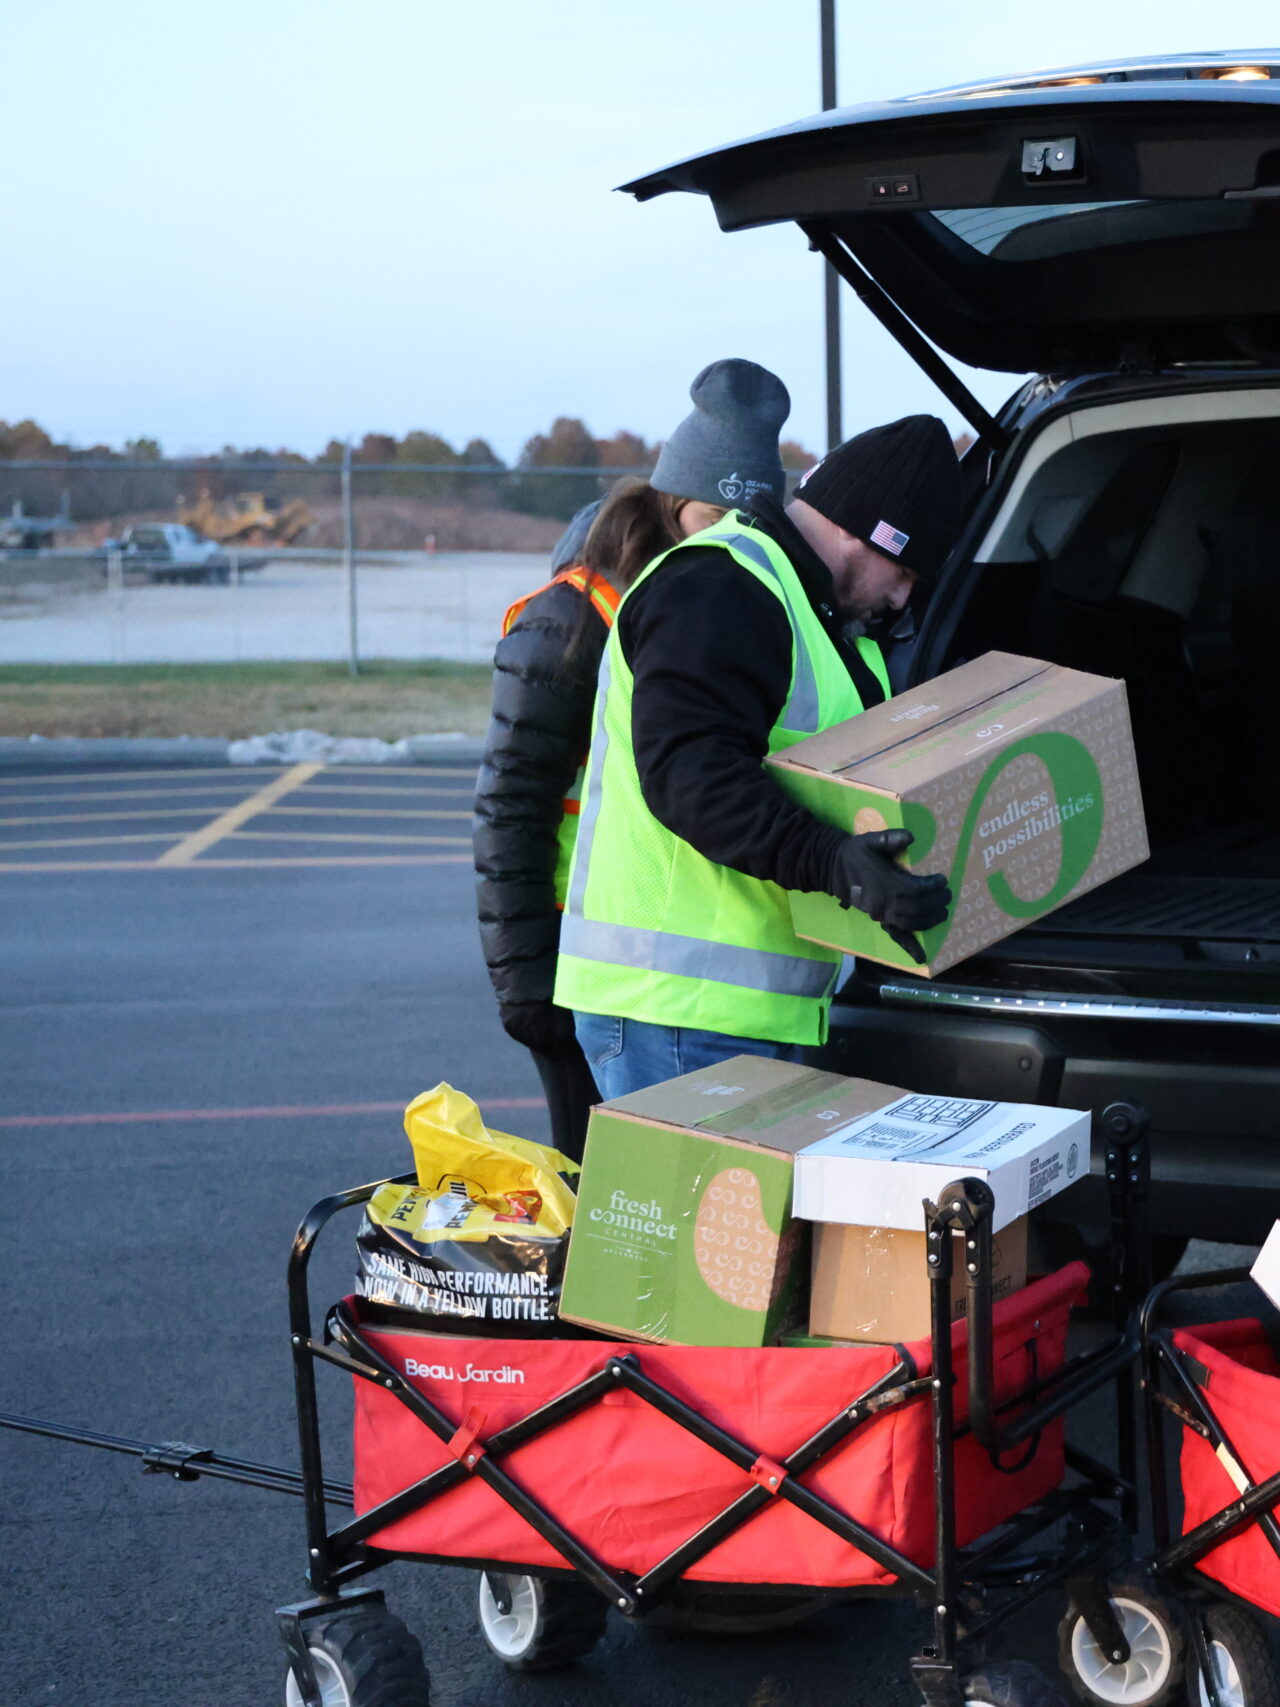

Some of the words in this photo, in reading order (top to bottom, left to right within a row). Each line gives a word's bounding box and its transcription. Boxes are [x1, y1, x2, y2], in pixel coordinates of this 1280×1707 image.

[979, 791, 1049, 838] endless
[982, 793, 1094, 870] possibilities
[589, 1207, 678, 1241] connect
[609, 1189, 662, 1221] fresh
[367, 1251, 407, 1279] SAME
[408, 1261, 440, 1287] HIGH
[437, 1270, 554, 1296] PERFORMANCE.
[363, 1275, 400, 1303] NOW
[400, 1282, 417, 1306] IN
[418, 1286, 429, 1309] A
[432, 1287, 487, 1318] YELLOW
[492, 1297, 555, 1320] BOTTLE.
[404, 1358, 454, 1380] Beau
[457, 1363, 525, 1384] Jardin
